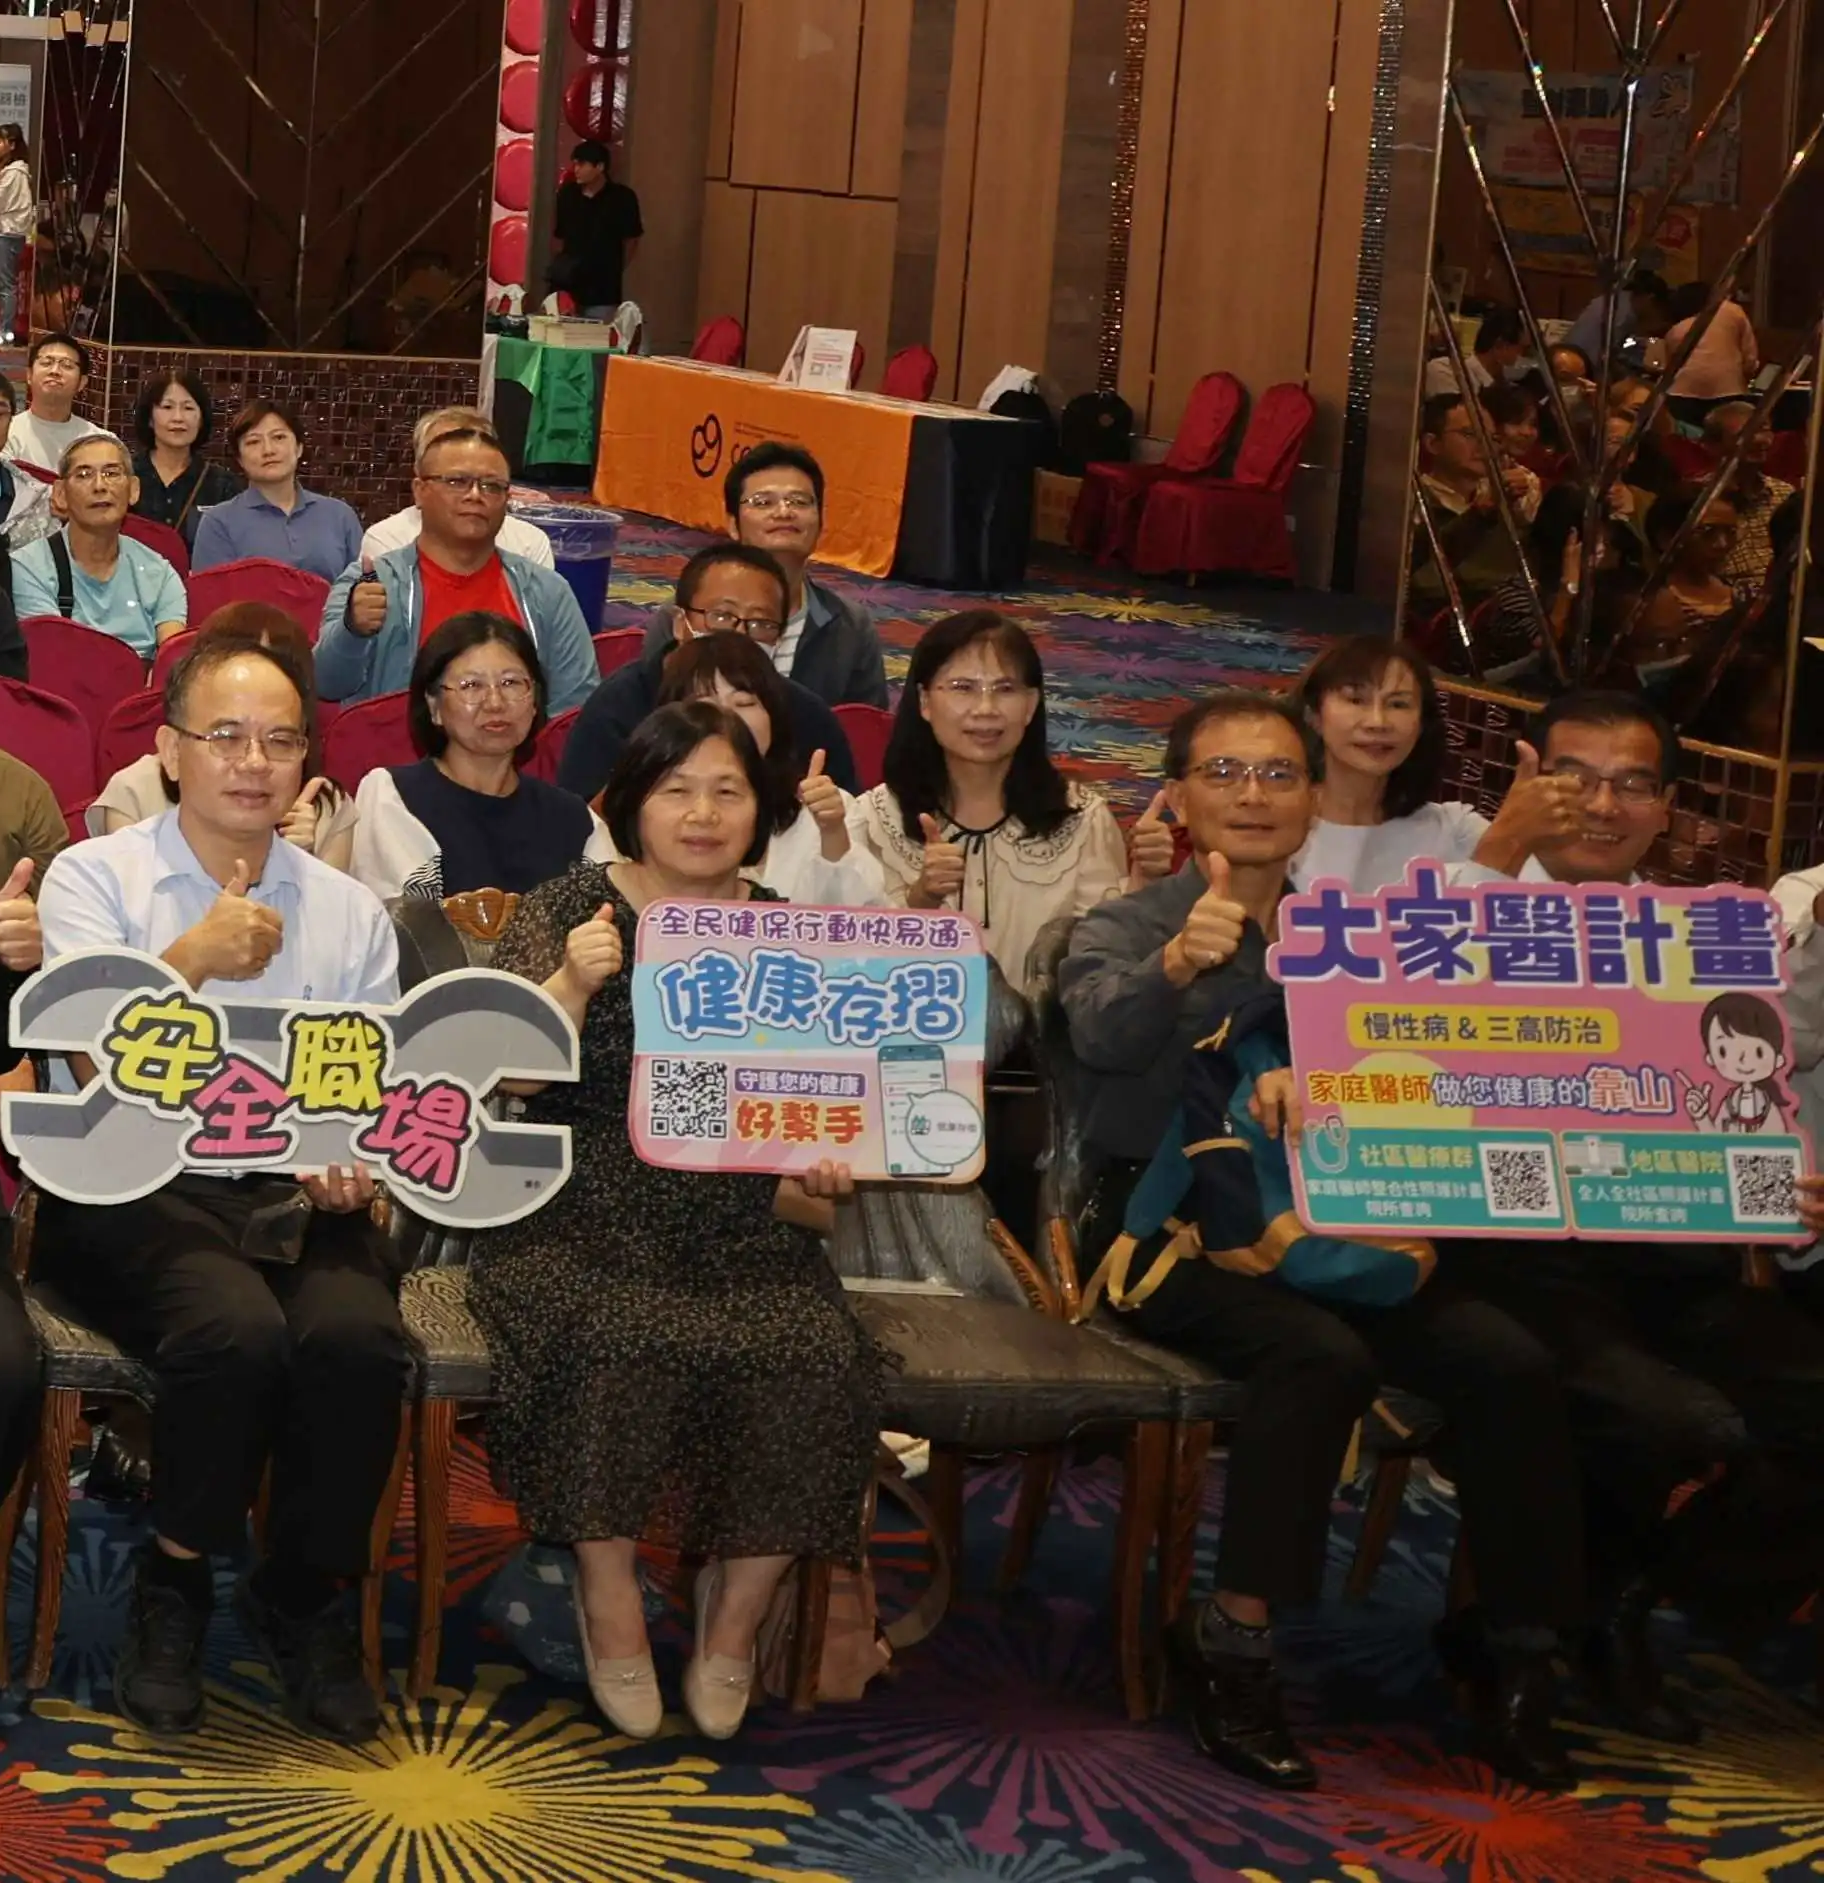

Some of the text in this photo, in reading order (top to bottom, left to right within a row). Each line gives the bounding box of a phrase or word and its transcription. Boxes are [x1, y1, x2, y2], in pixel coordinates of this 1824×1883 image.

[1277, 869, 1786, 988] 大家醫計畫
[660, 951, 962, 1042] 健康存摺
[1363, 1010, 1603, 1045] 慢性病 & 三高防治
[109, 996, 467, 1190] 安全職場
[738, 1070, 861, 1096] 守護您的健康
